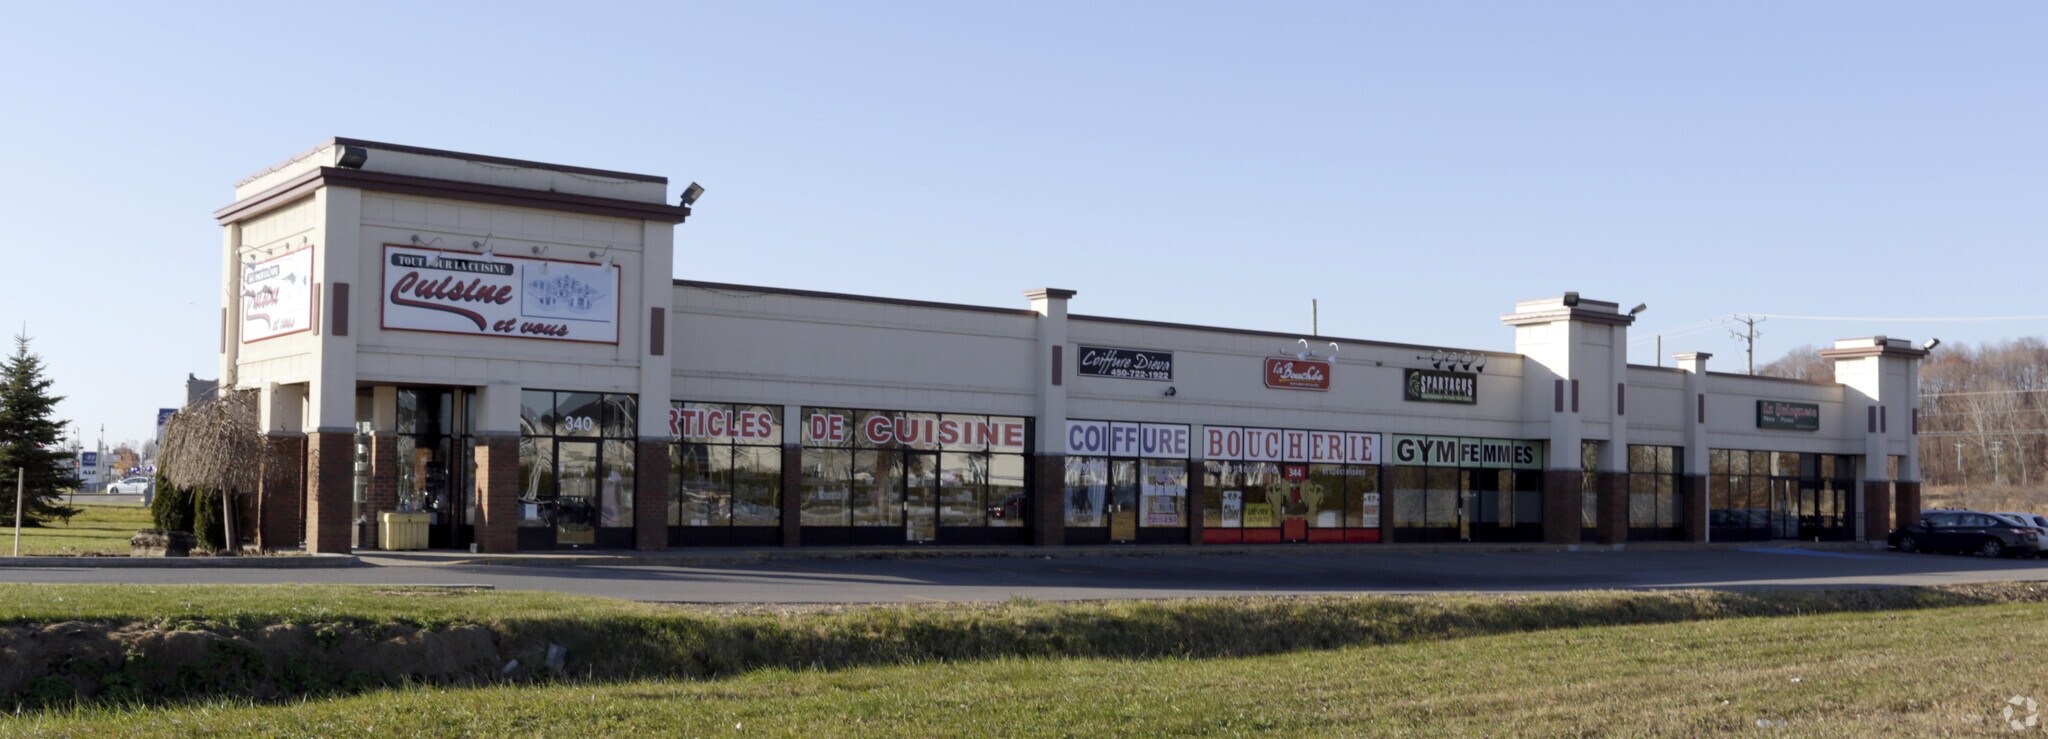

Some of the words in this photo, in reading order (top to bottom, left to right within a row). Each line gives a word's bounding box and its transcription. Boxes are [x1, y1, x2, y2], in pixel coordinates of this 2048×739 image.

[398, 255, 424, 267] TOUT
[426, 257, 453, 269] UR
[454, 261, 467, 271] LA
[468, 261, 506, 274] CUISINE
[390, 271, 513, 307] Cuisine
[493, 318, 516, 333] et
[520, 320, 569, 336] vous
[1082, 349, 1131, 375] Coiffure
[1110, 368, 1169, 380] 450-722-1922
[1421, 375, 1473, 397] SPARTACUS
[565, 415, 593, 432] 340
[811, 414, 843, 441] DE
[867, 416, 1024, 447] CUISINE
[1069, 424, 1187, 454] COIFFURE
[1208, 428, 1372, 461] BOUCHERIE
[1397, 438, 1455, 463] GYM
[1461, 443, 1533, 464] FEMMES
